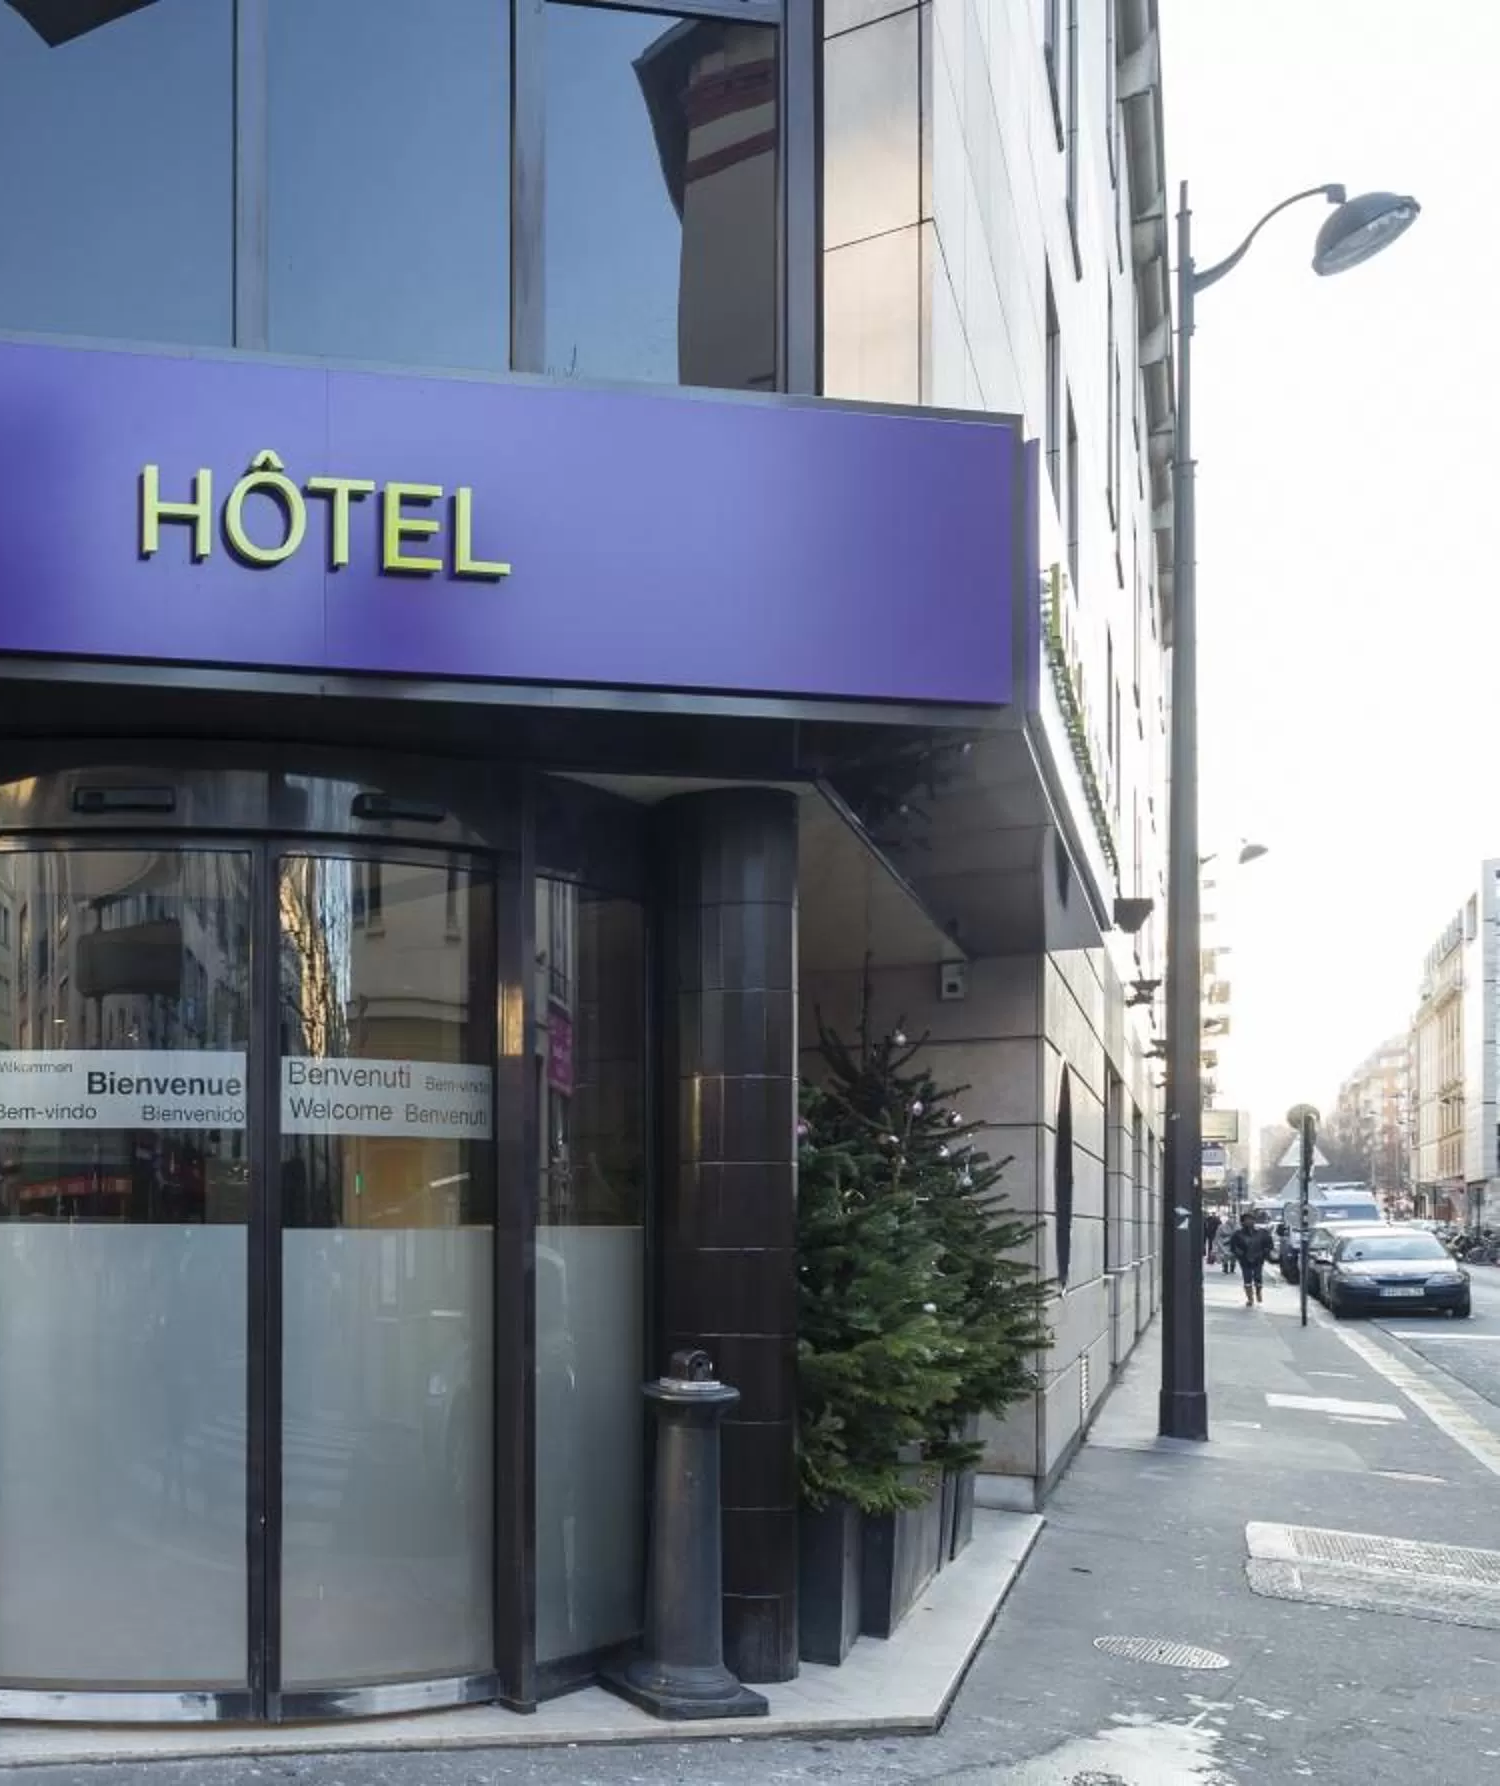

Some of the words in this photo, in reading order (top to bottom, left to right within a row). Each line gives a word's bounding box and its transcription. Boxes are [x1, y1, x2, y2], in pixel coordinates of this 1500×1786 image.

[140, 449, 511, 576] HÔTEL
[87, 1071, 242, 1096] Bienvenue
[289, 1061, 411, 1088] Benvenuti
[142, 1104, 245, 1122] Bienvenido
[289, 1097, 393, 1121] Welcome
